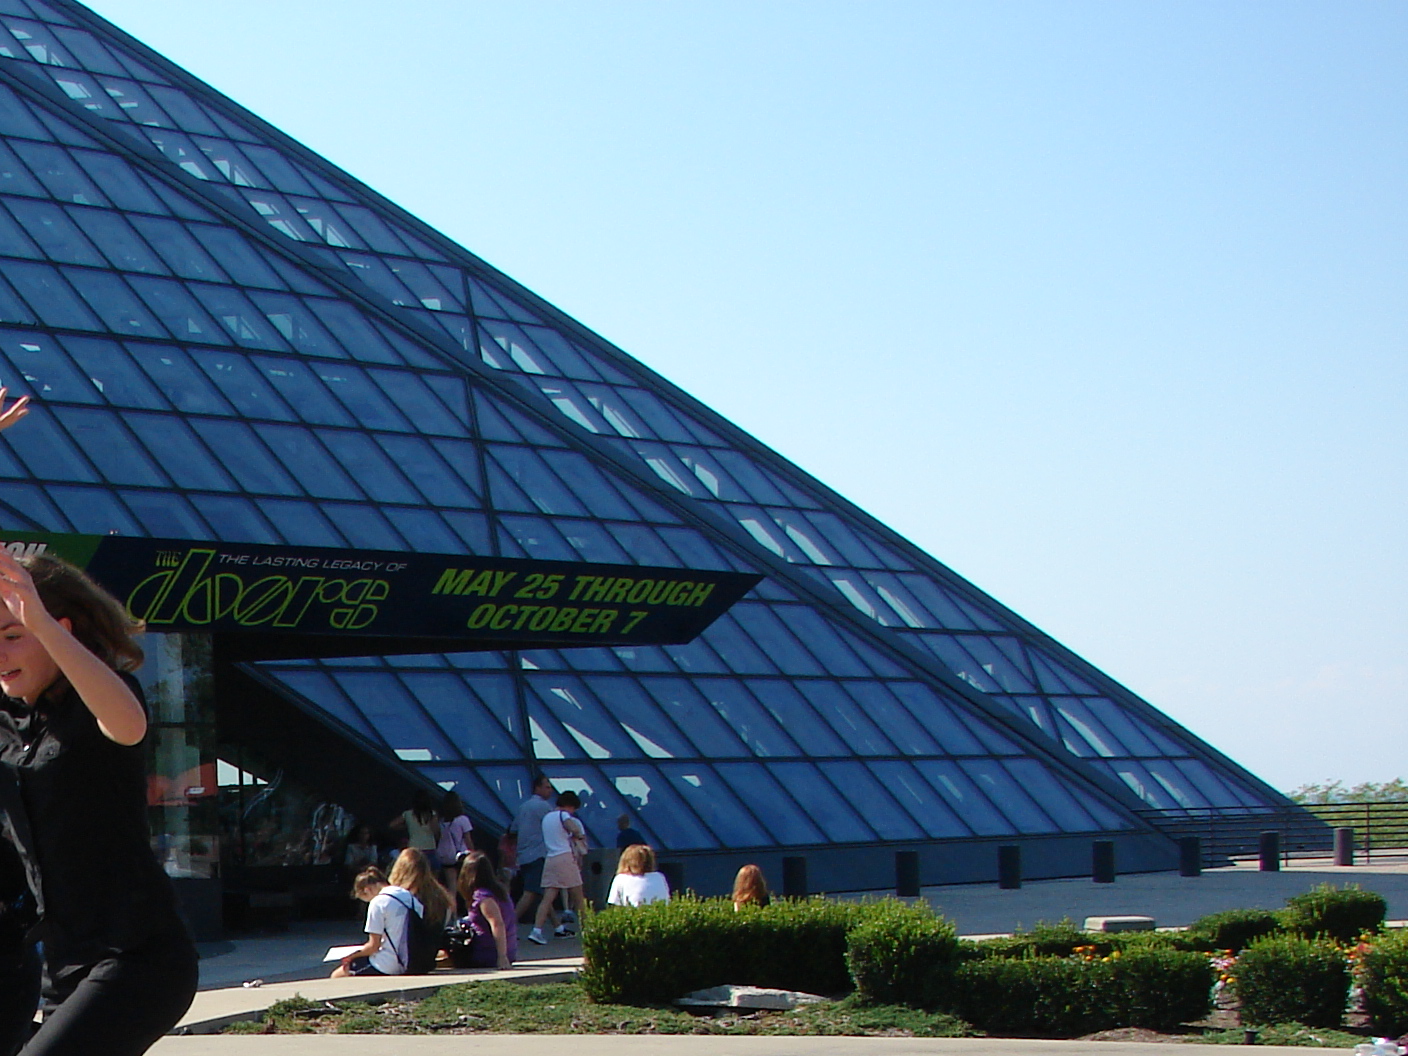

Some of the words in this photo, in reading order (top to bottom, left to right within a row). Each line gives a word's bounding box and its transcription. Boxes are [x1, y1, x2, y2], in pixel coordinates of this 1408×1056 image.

[155, 551, 182, 567] THE
[219, 554, 250, 566] THE
[253, 556, 320, 569] LASTING
[323, 559, 384, 572] LEGACY
[386, 562, 408, 572] OF
[431, 568, 517, 598] MAY
[514, 573, 566, 600] 25
[568, 575, 716, 607] THROUGH
[467, 603, 619, 634] OCTOBER
[620, 611, 648, 635] 7
